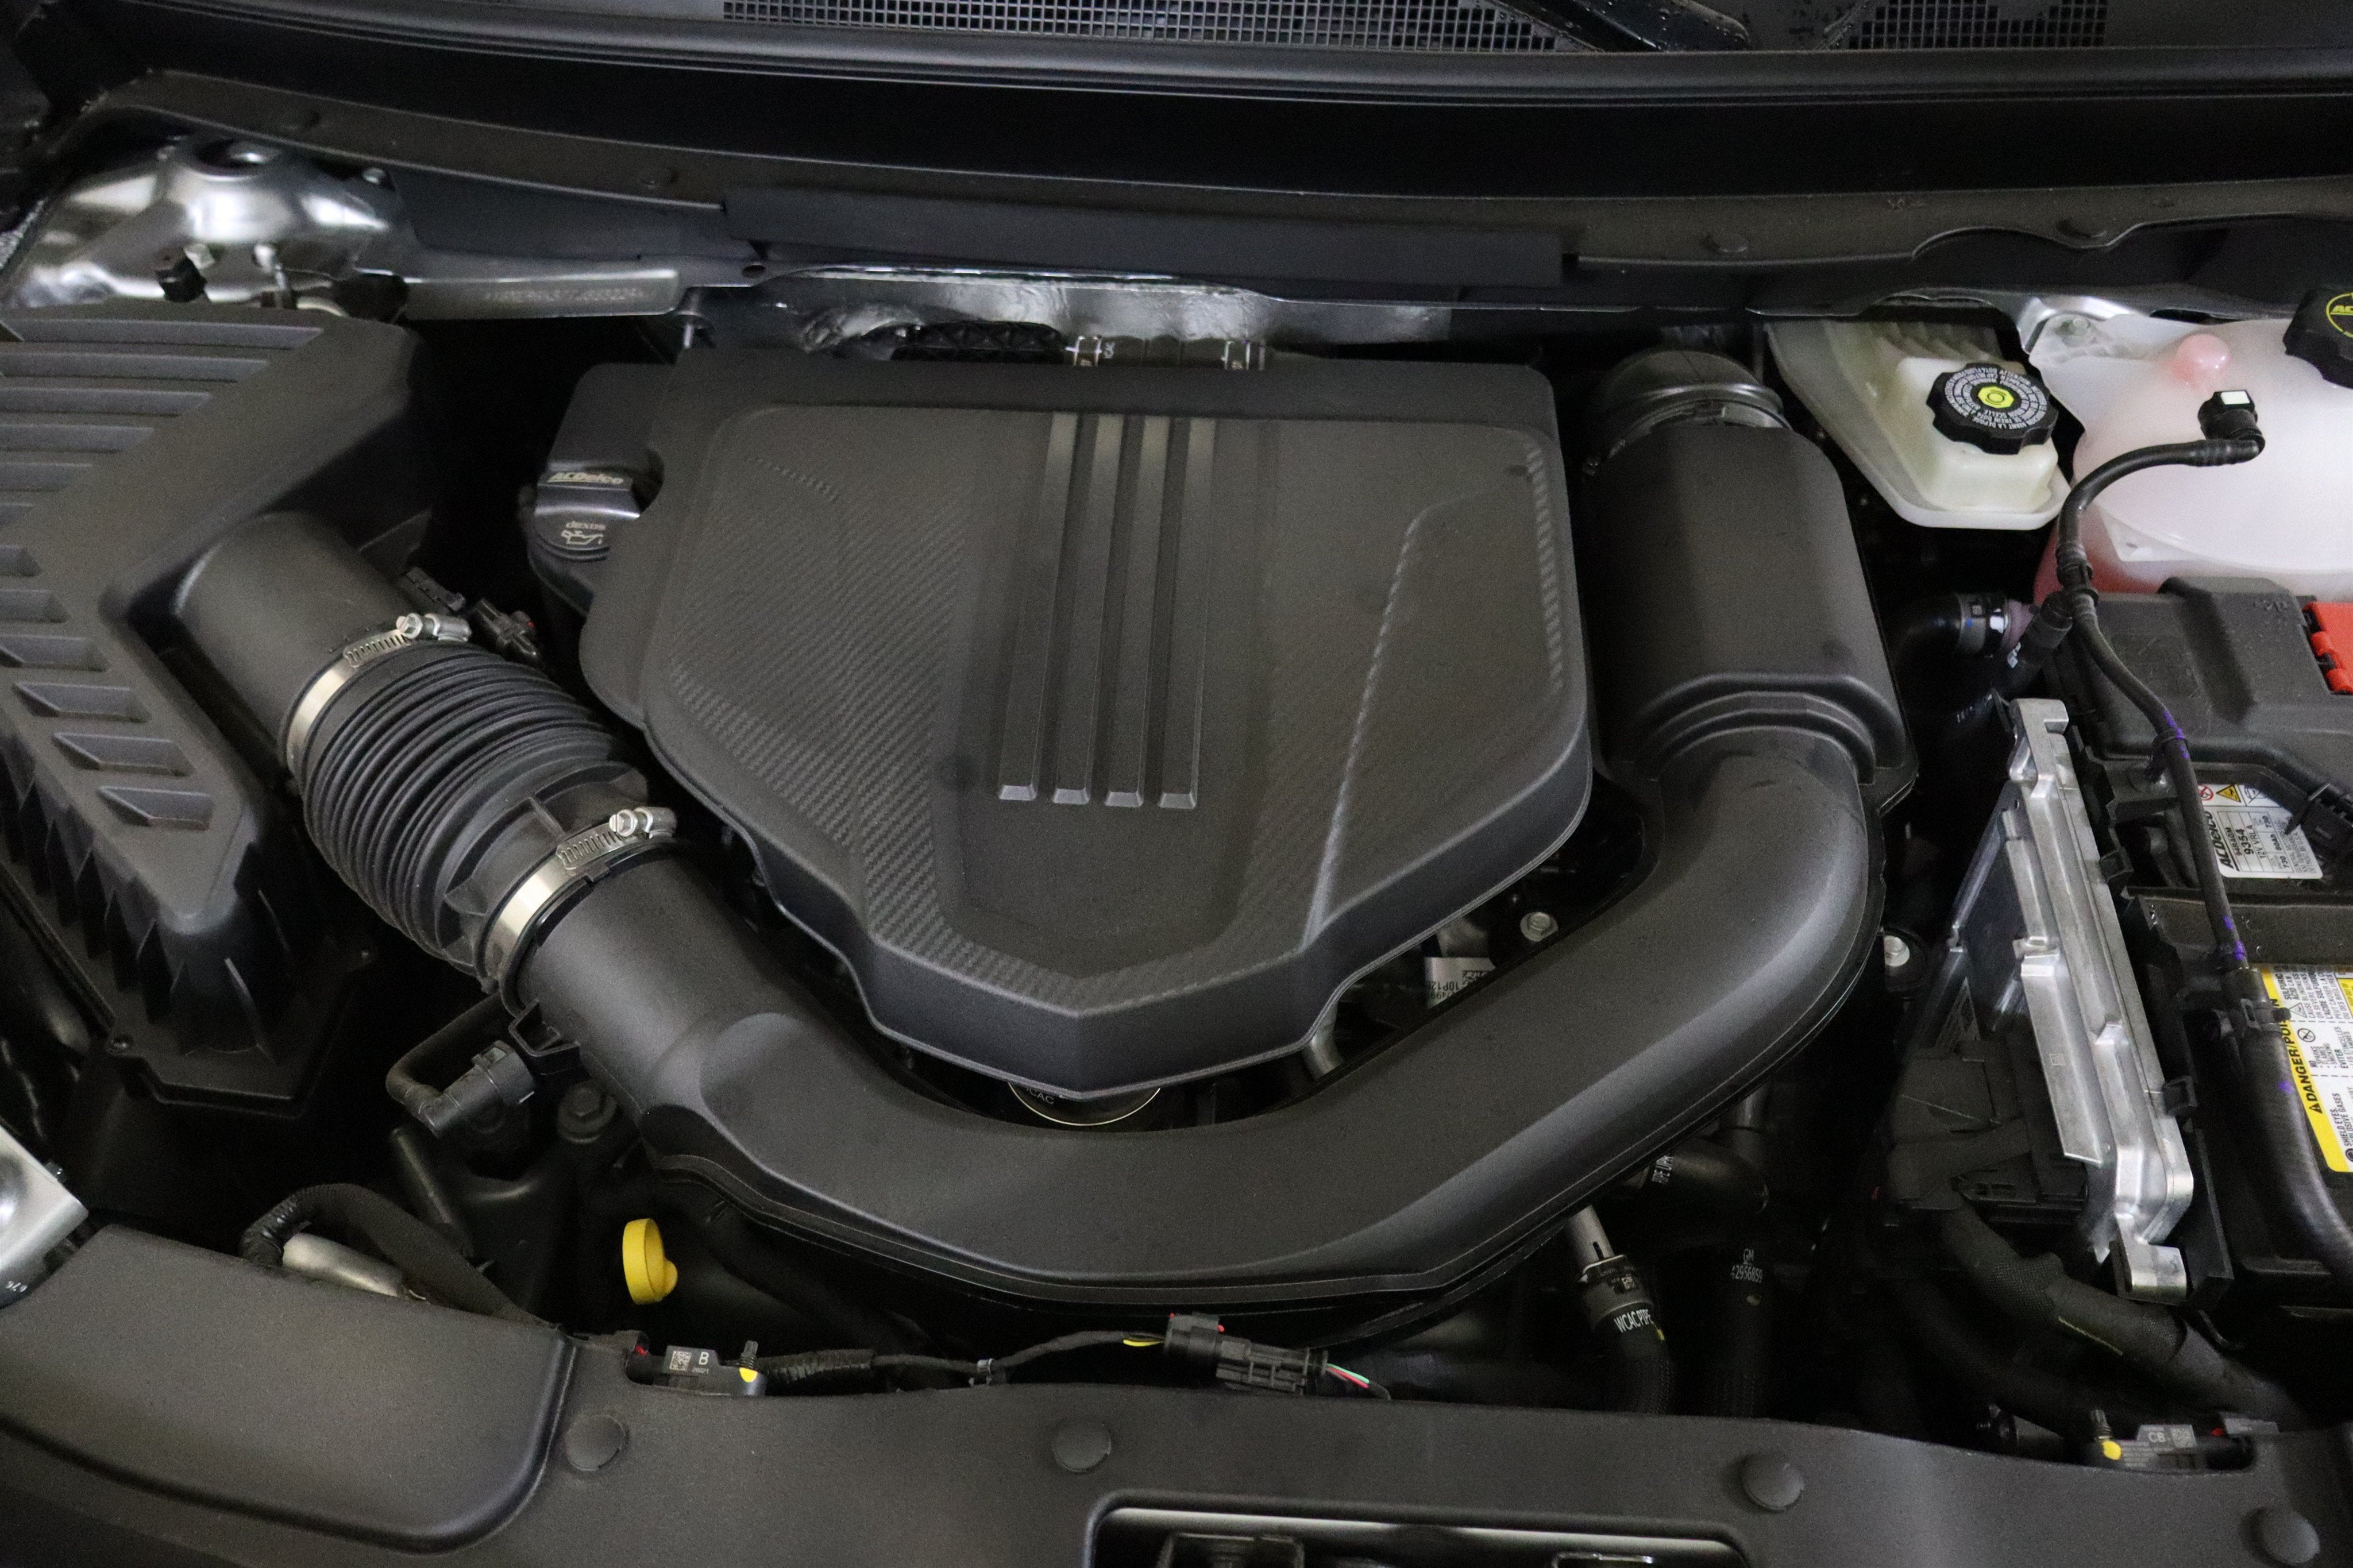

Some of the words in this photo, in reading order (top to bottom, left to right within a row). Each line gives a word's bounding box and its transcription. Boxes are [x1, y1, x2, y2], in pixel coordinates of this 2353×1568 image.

[2235, 829, 2254, 855] 9354
[2275, 974, 2292, 999] SULFURIC
[2286, 976, 2294, 986] CAN
[2301, 974, 2312, 990] BURNS
[2289, 987, 2300, 1000] ACID
[2308, 992, 2320, 1010] SEVERE
[2323, 986, 2336, 1005] CAUSER
[2304, 1002, 2316, 1018] CAUSE
[2331, 1007, 2342, 1019] PEUT
[2337, 1002, 2346, 1011] DES
[2269, 998, 2317, 1102] DANGER/POIN
[2332, 1093, 2346, 1112] GASES
[2337, 1126, 2352, 1146] SHIELD
[699, 1351, 709, 1365] B
